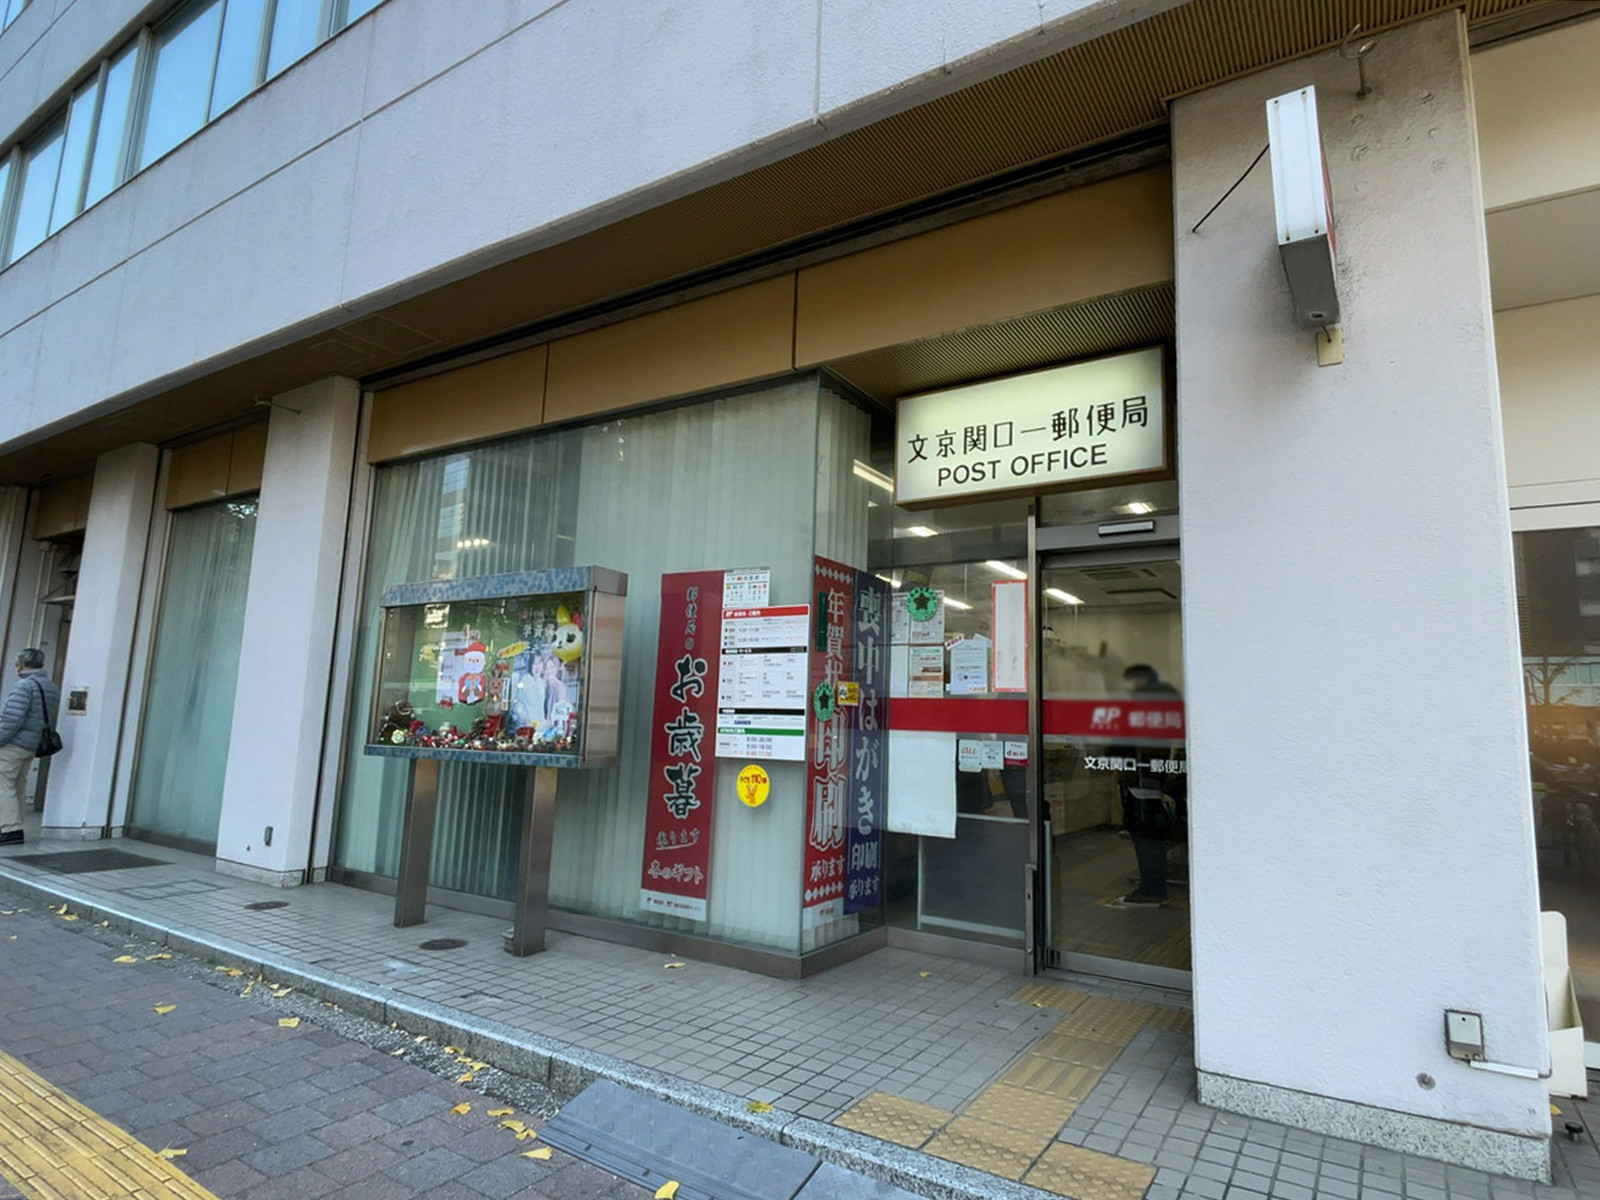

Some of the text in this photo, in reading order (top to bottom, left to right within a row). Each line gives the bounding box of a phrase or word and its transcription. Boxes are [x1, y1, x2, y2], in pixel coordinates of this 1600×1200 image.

[907, 396, 1148, 464] 文京関口一郵便局
[938, 444, 1108, 487] POST OFFICE
[664, 653, 709, 819] お歳暮
[648, 860, 704, 885] 冬のギフト
